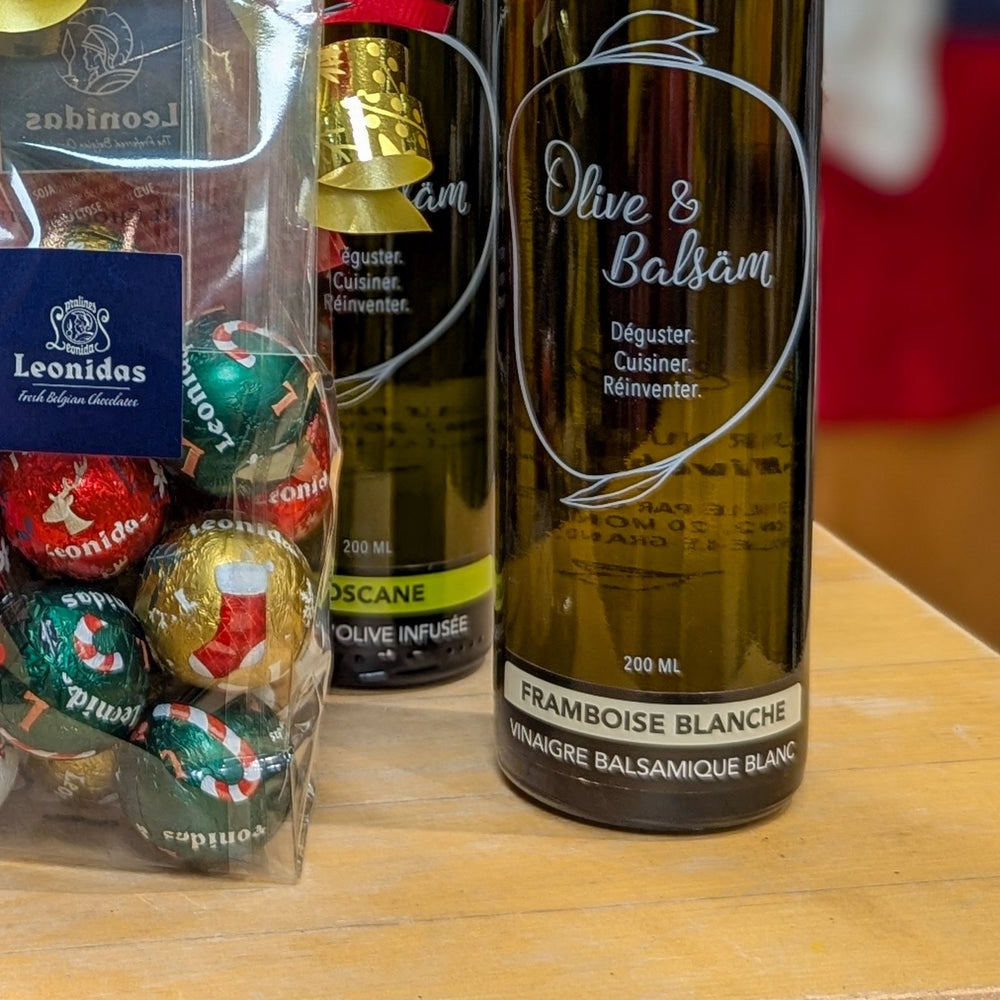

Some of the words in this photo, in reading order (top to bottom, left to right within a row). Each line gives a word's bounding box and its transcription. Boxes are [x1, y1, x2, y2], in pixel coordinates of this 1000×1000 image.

[545, 140, 651, 224] Olive
[668, 179, 699, 224] &
[341, 247, 404, 269] éguster.
[602, 228, 775, 290] Balsäm
[333, 271, 402, 291] Cuisiner.
[324, 293, 410, 314] Réinventer.
[611, 321, 695, 347] Déguster.
[14, 353, 146, 383] Leonidas
[614, 349, 692, 373] Cuisiner.
[18, 389, 45, 403] Fresh
[46, 390, 86, 408] Belgian
[604, 375, 702, 399] Réinventer.
[343, 539, 369, 554] 200
[373, 540, 393, 554] ML
[330, 583, 425, 604] OSCANE
[331, 623, 394, 644] 'OLIVE
[399, 614, 469, 644] INFUSÉE
[623, 654, 652, 673] 200
[658, 656, 681, 674] ML
[521, 680, 666, 735] FRAMBOISE
[675, 700, 786, 735] BLANCHE
[509, 717, 588, 768] VINAIGRE
[595, 751, 740, 778] BALSAMIQUE
[744, 740, 796, 774] BLANC
